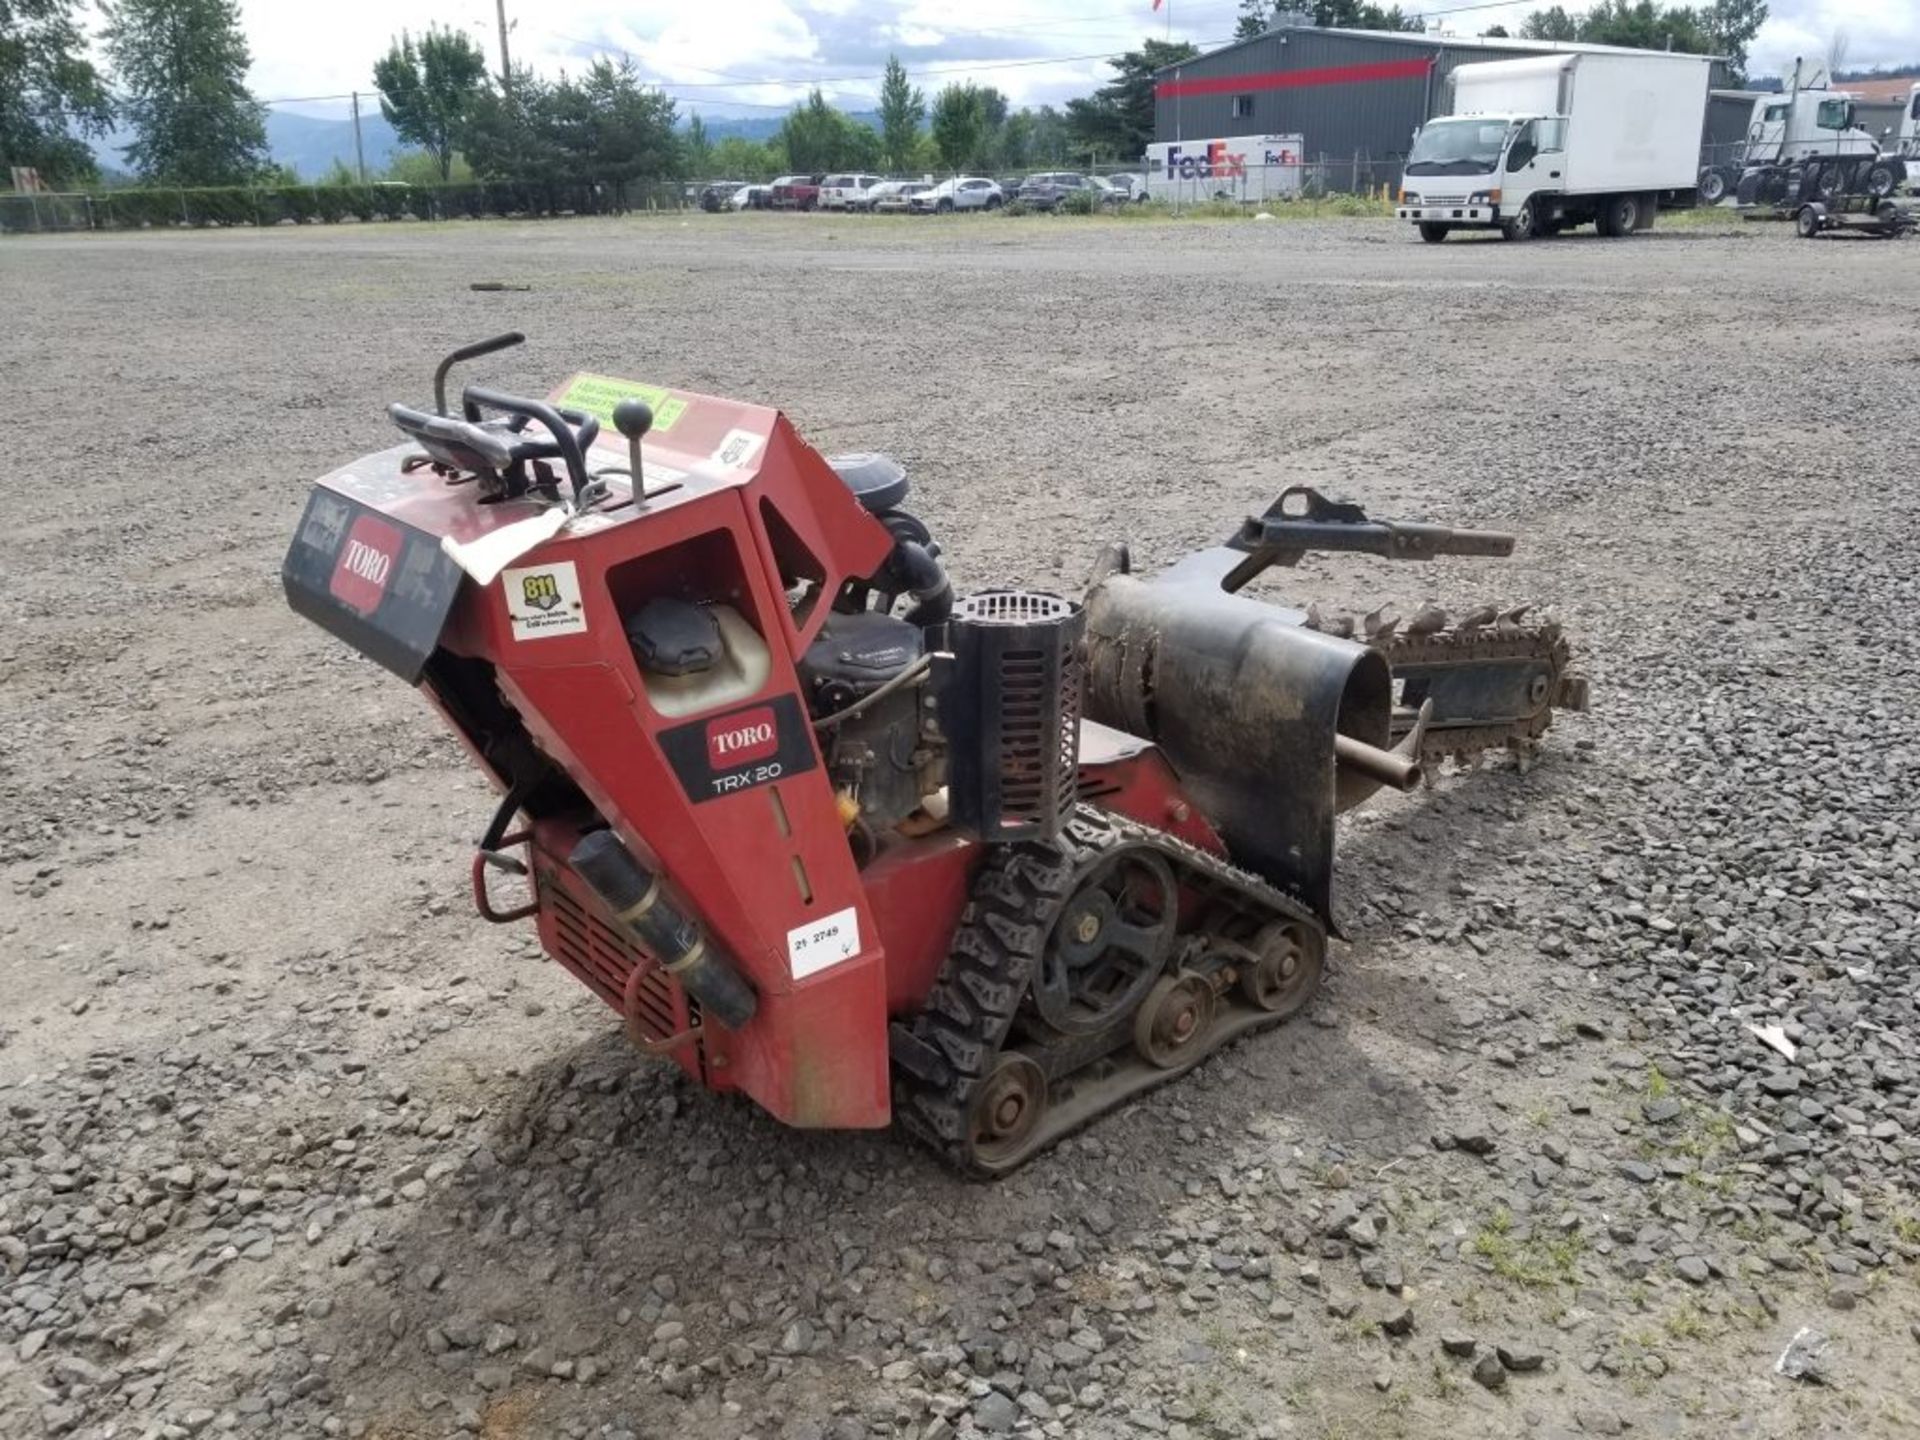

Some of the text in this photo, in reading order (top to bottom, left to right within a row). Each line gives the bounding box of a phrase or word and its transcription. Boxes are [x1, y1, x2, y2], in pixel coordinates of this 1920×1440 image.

[1167, 141, 1247, 180] FedEx
[1265, 149, 1297, 165] FedEx
[344, 539, 390, 584] TORO
[523, 573, 558, 601] 811
[712, 723, 772, 753] TORO
[711, 762, 782, 794] TRX 20
